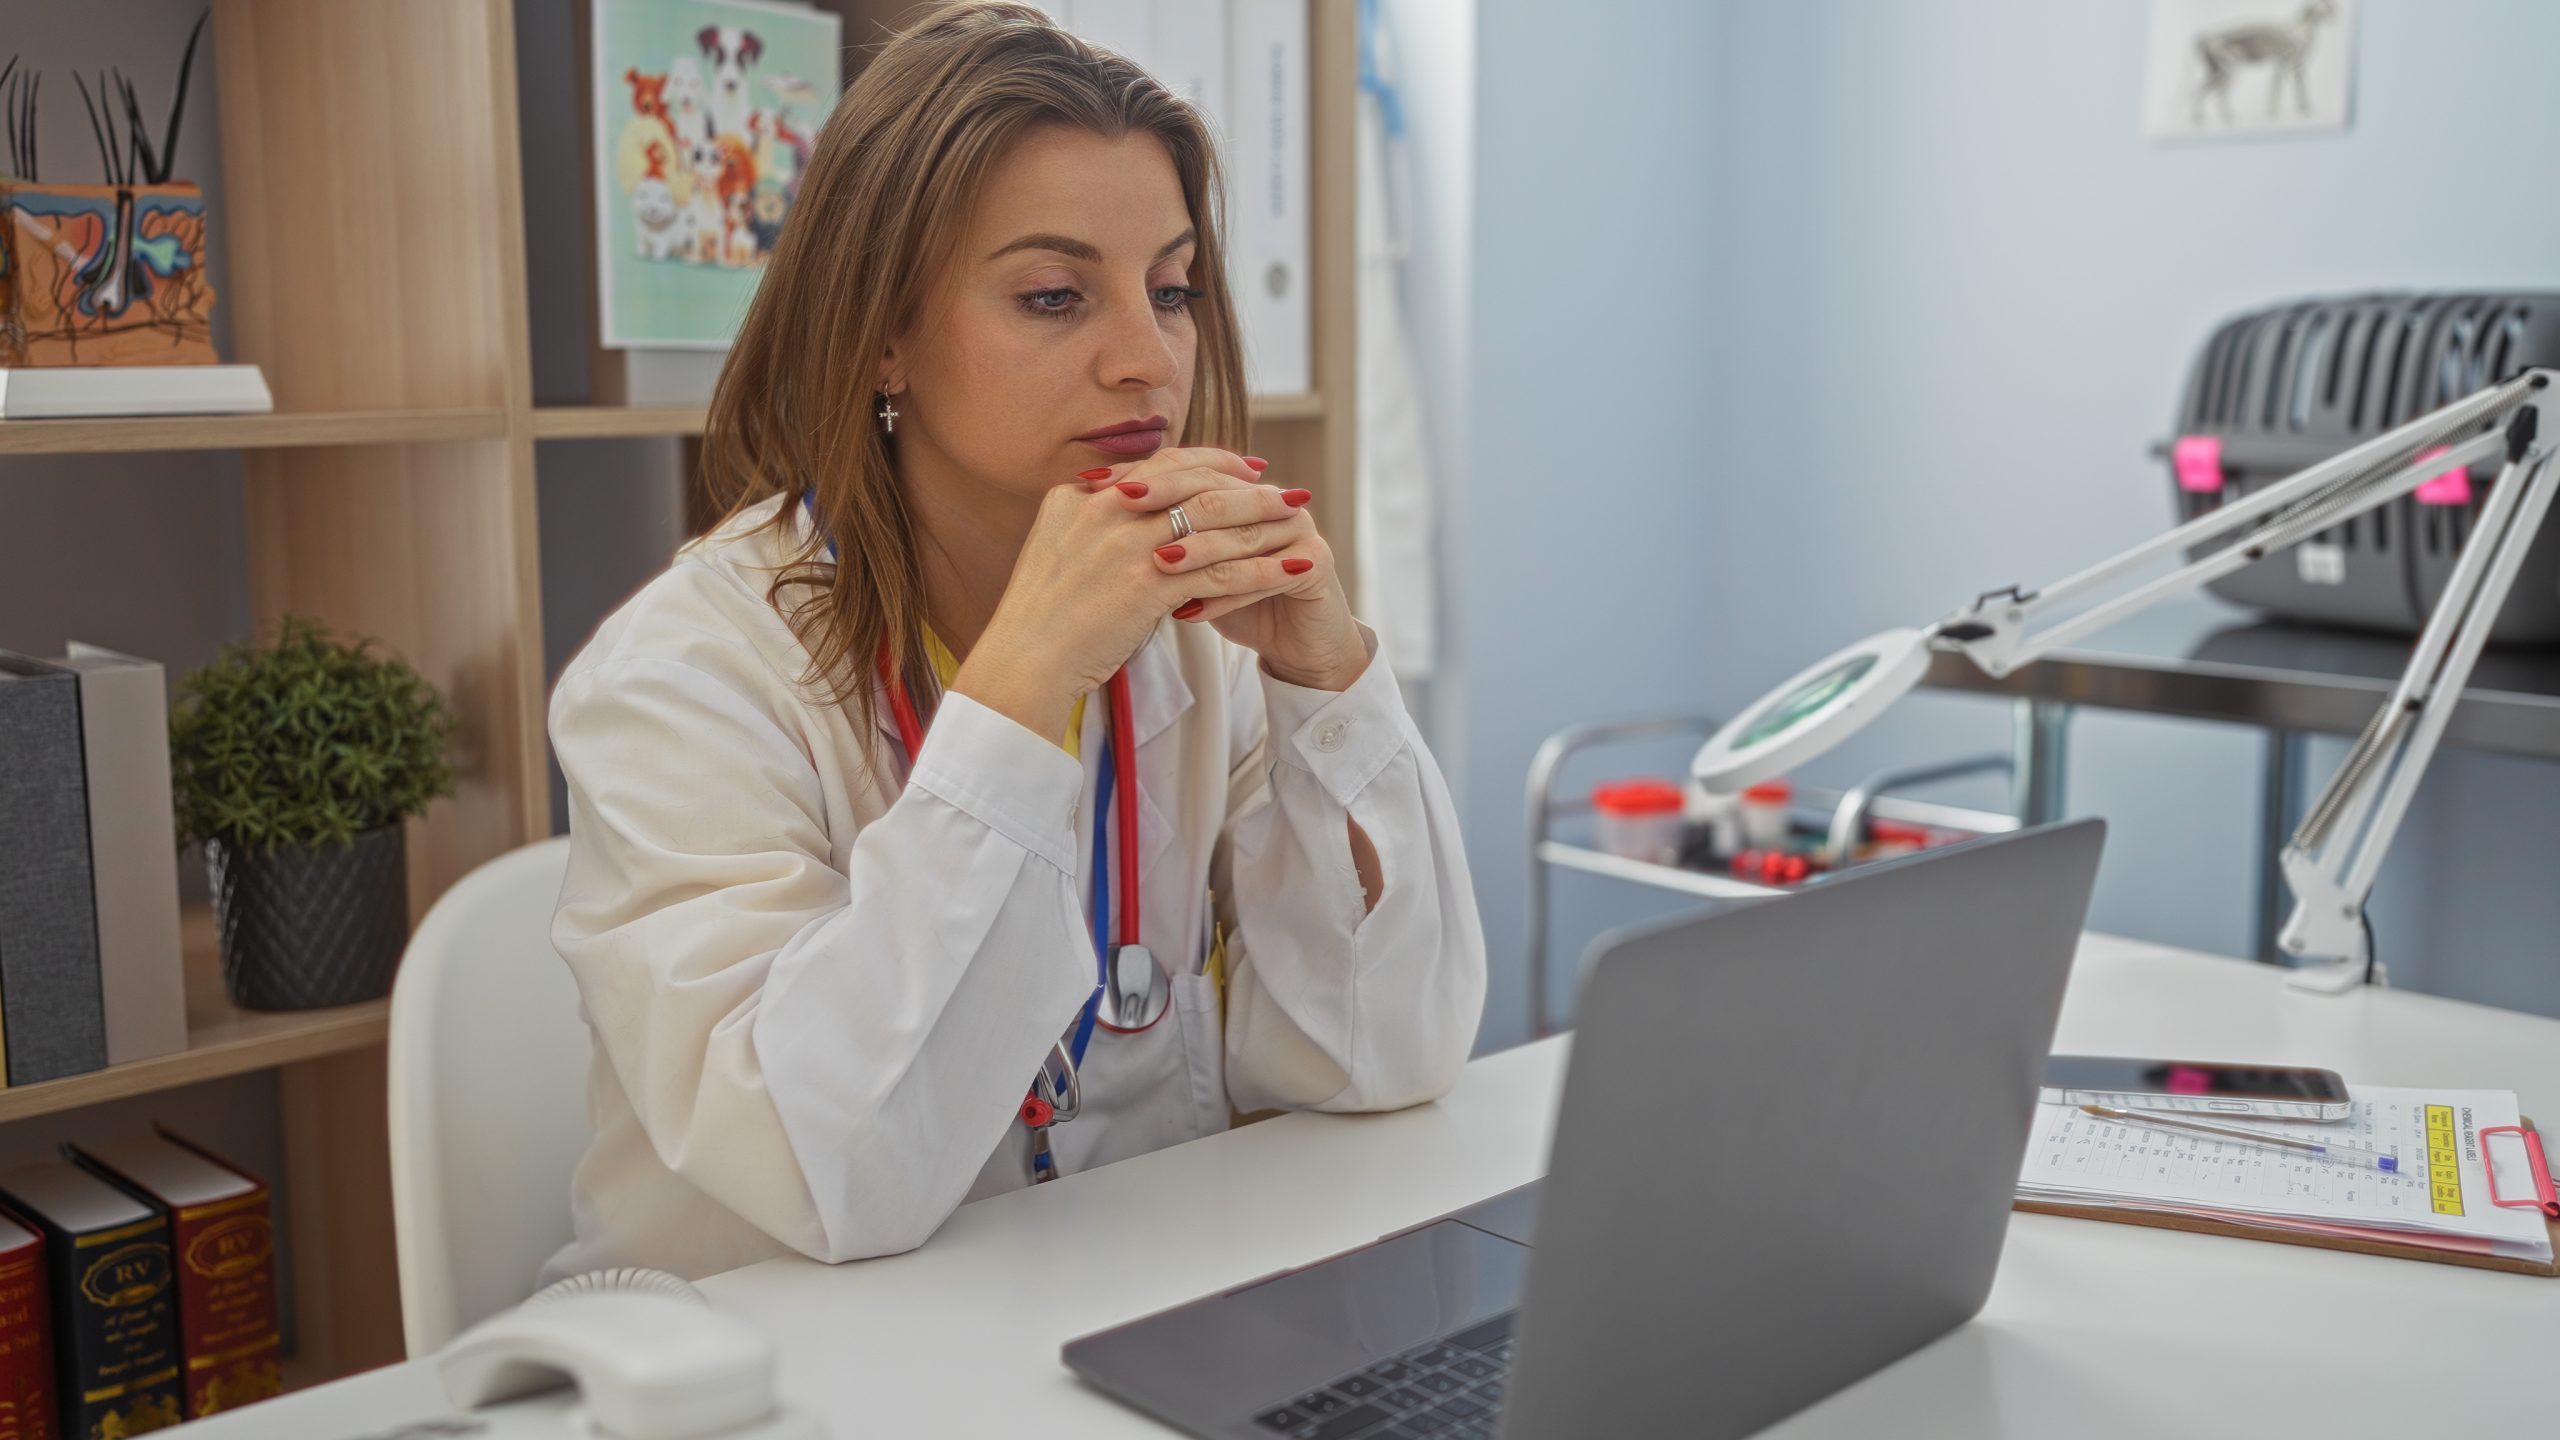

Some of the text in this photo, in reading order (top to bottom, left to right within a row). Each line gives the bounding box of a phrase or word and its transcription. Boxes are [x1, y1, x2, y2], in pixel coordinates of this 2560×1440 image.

[2461, 1107, 2478, 1161] CHEMICAL REAGENT LABELS
[218, 1231, 253, 1255] RV
[116, 1260, 151, 1283] RV
